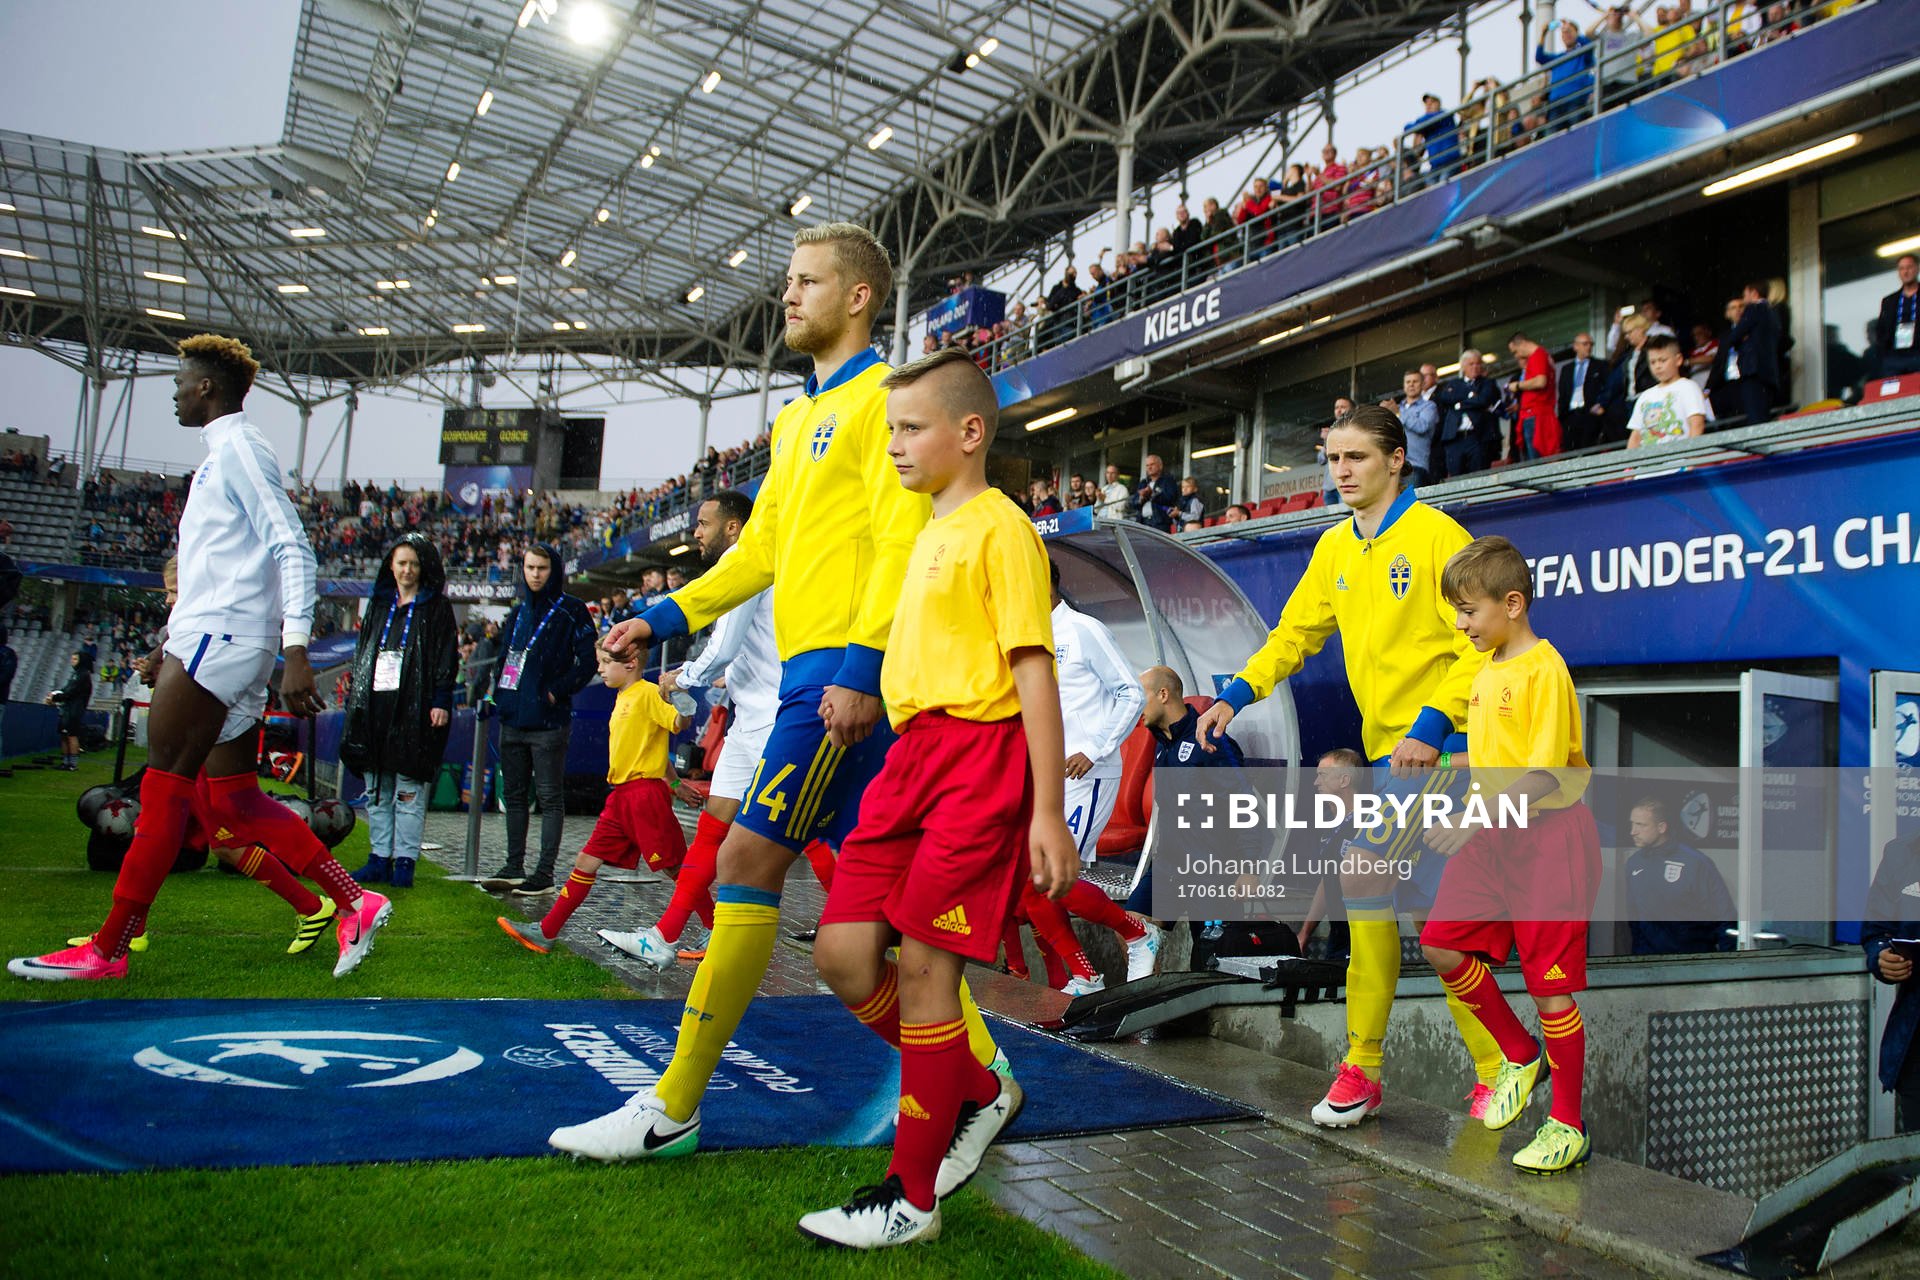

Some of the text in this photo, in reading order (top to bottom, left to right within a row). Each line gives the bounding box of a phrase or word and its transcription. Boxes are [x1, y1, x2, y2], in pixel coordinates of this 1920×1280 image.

[1144, 288, 1221, 346] KIELCE
[1300, 472, 1324, 491] KIELC
[1527, 512, 1920, 598] FA UNDER-21 CH
[447, 583, 495, 597] POLAND
[742, 758, 797, 822] 14
[932, 917, 972, 936] adidas
[887, 1221, 918, 1242] adidas
